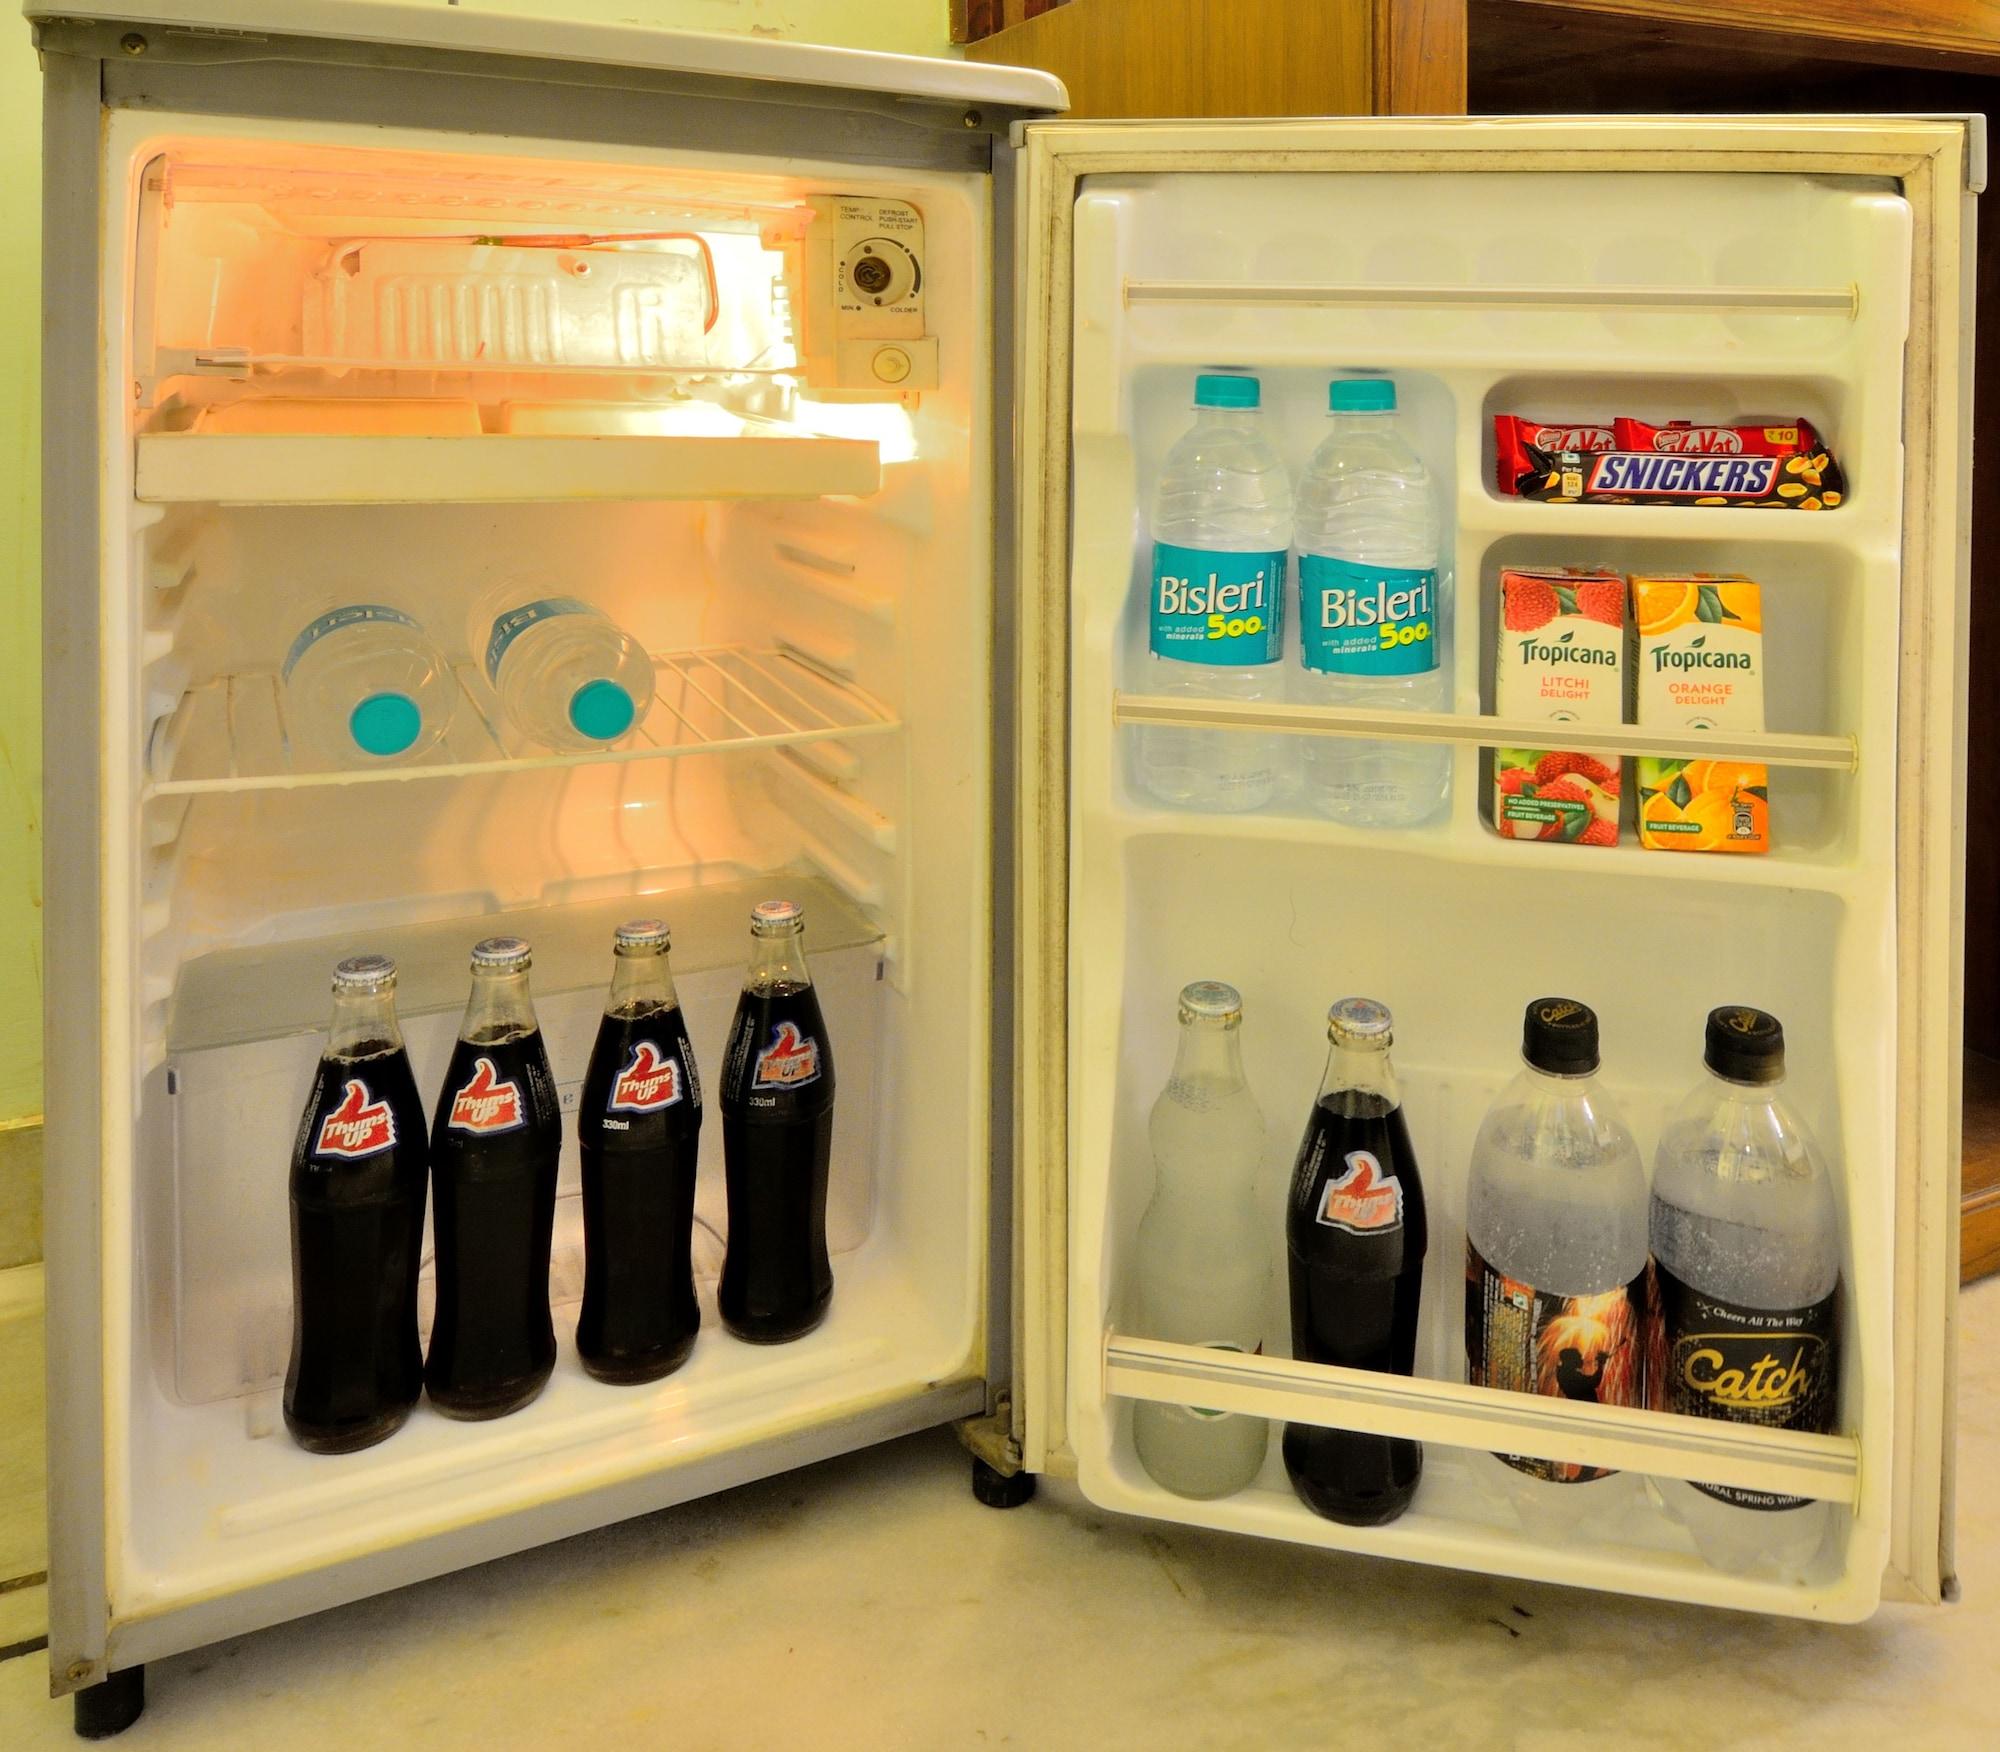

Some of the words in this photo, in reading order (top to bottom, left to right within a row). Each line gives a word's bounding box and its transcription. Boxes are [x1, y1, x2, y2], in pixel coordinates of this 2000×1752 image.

[839, 213, 873, 221] CONTROL
[879, 208, 908, 216] DEFROST
[1597, 455, 1775, 493] SNICKERS
[1159, 570, 1265, 616] Bisleri
[1321, 577, 1427, 629] Bisleri
[1174, 625, 1205, 633] added
[1207, 614, 1262, 640] 500
[1165, 632, 1205, 640] minerals
[1321, 639, 1340, 647] with
[1342, 636, 1377, 646] added
[1379, 621, 1429, 650] 500
[1332, 644, 1377, 654] minerals
[1518, 637, 1616, 666] Tropicana
[1649, 642, 1752, 673] Tropicana
[1542, 676, 1590, 689] LITCHI
[1540, 688, 1591, 700] DELIGHT
[1668, 683, 1733, 695] ORANGE
[1675, 695, 1727, 705] DELIGHT
[1540, 800, 1585, 810] PRESERVATIVES
[1507, 811, 1524, 819] FRUIT
[1525, 812, 1556, 821] BEVERAGE
[1649, 822, 1668, 831] FRUIT
[1668, 823, 1700, 832] BEVERAGE
[621, 1072, 671, 1095] Thums
[457, 1091, 514, 1114] Thums
[748, 1096, 776, 1107] 330ml
[326, 1112, 386, 1140] Thums
[602, 1118, 630, 1130] 330ml
[1713, 1306, 1746, 1323] Cheers
[1747, 1316, 1763, 1327] All
[1766, 1317, 1784, 1327] The
[1785, 1316, 1804, 1328] Way
[1685, 1346, 1808, 1401] Catch
[1735, 1491, 1775, 1506] SPRING
